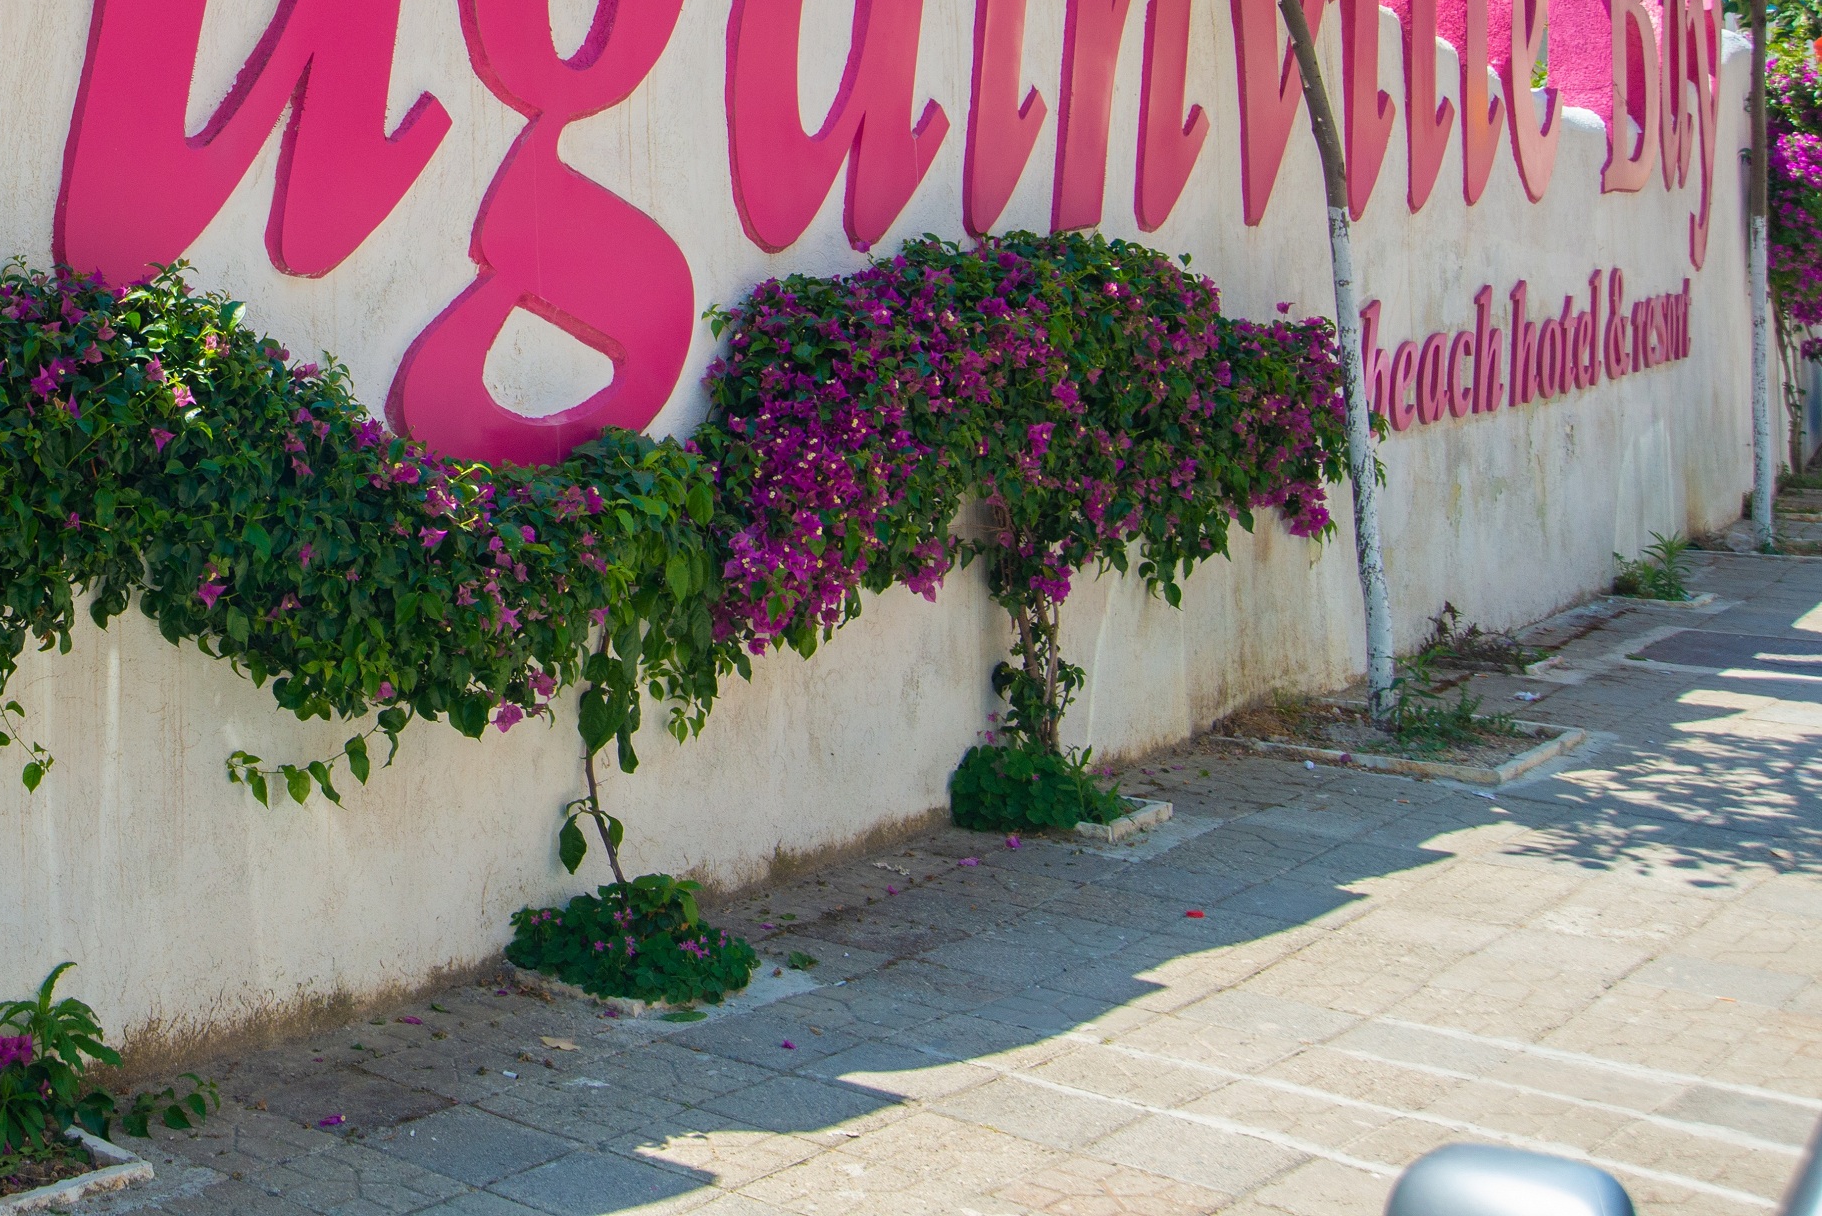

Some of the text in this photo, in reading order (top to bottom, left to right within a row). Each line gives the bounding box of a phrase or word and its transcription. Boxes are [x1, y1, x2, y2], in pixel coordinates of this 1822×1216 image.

[1360, 267, 1692, 438] beach hotel & resort
